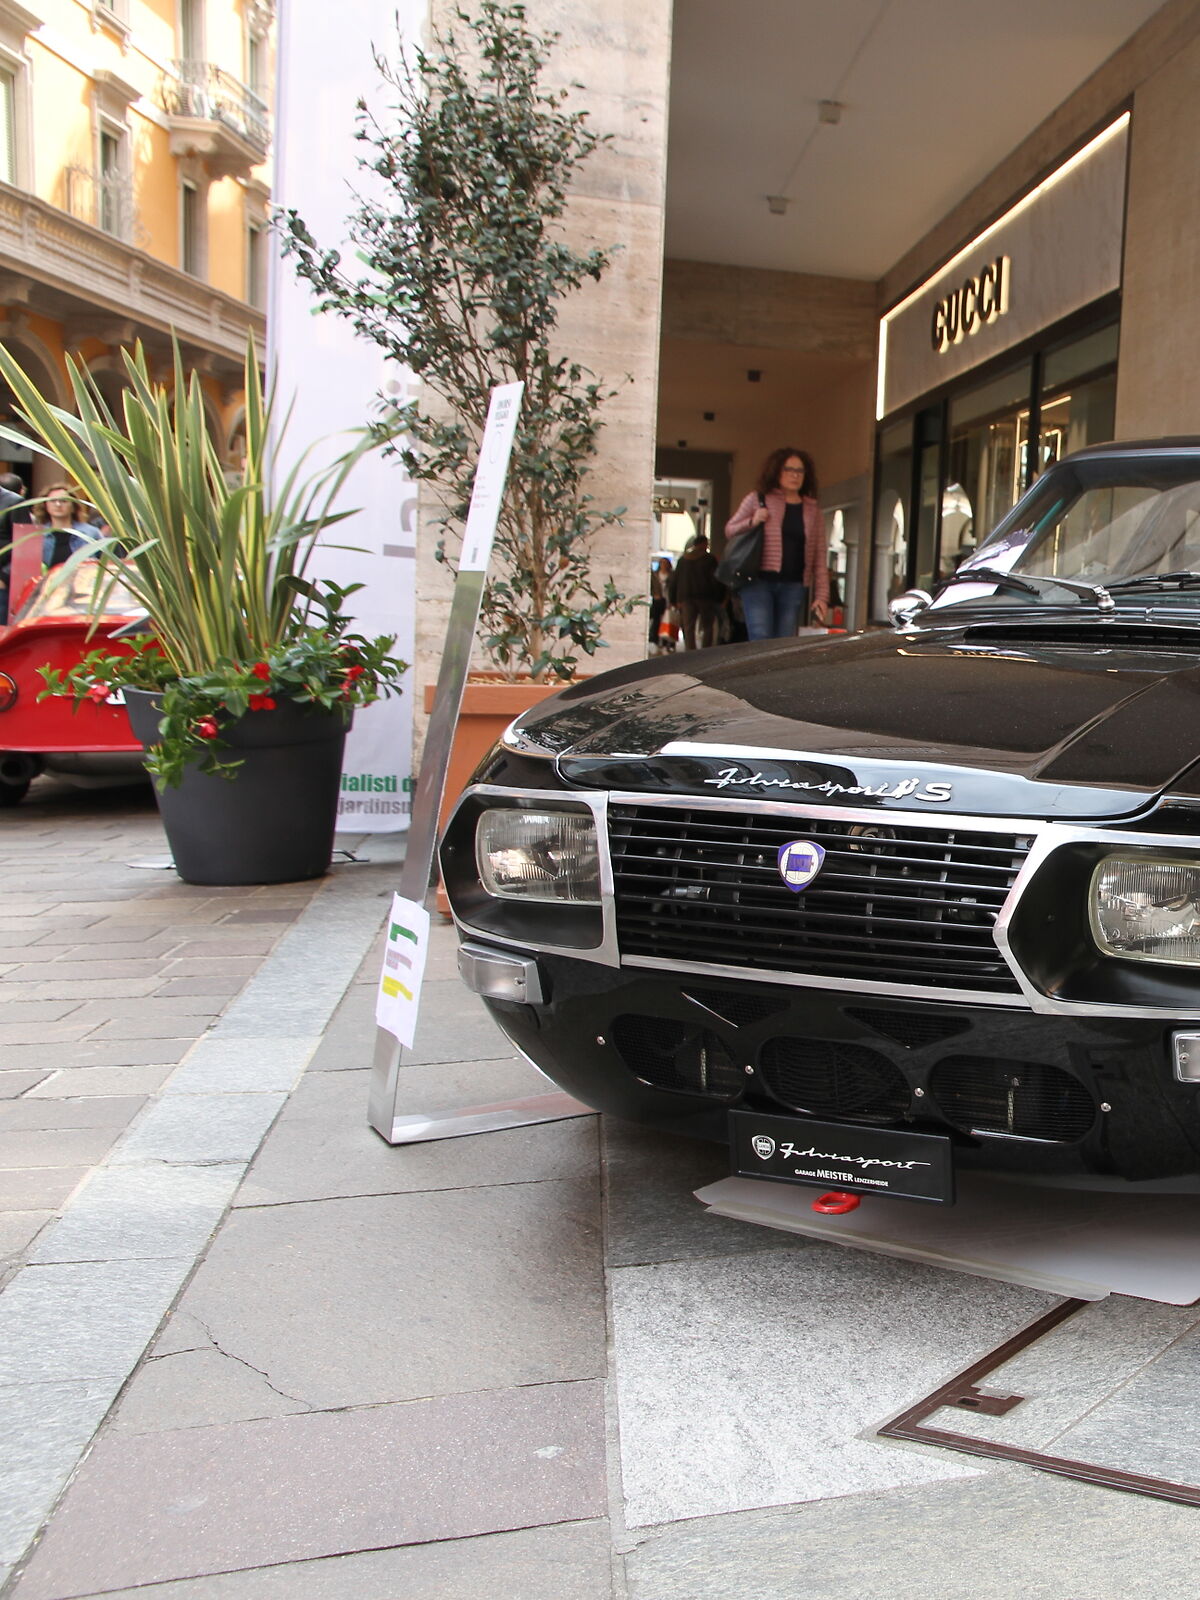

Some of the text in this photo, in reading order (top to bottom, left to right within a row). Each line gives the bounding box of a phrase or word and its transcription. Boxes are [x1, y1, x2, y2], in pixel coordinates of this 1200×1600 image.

[931, 255, 1010, 354] GUCCI
[794, 1168, 816, 1177] GARAGE
[816, 1168, 854, 1182] MEISTER
